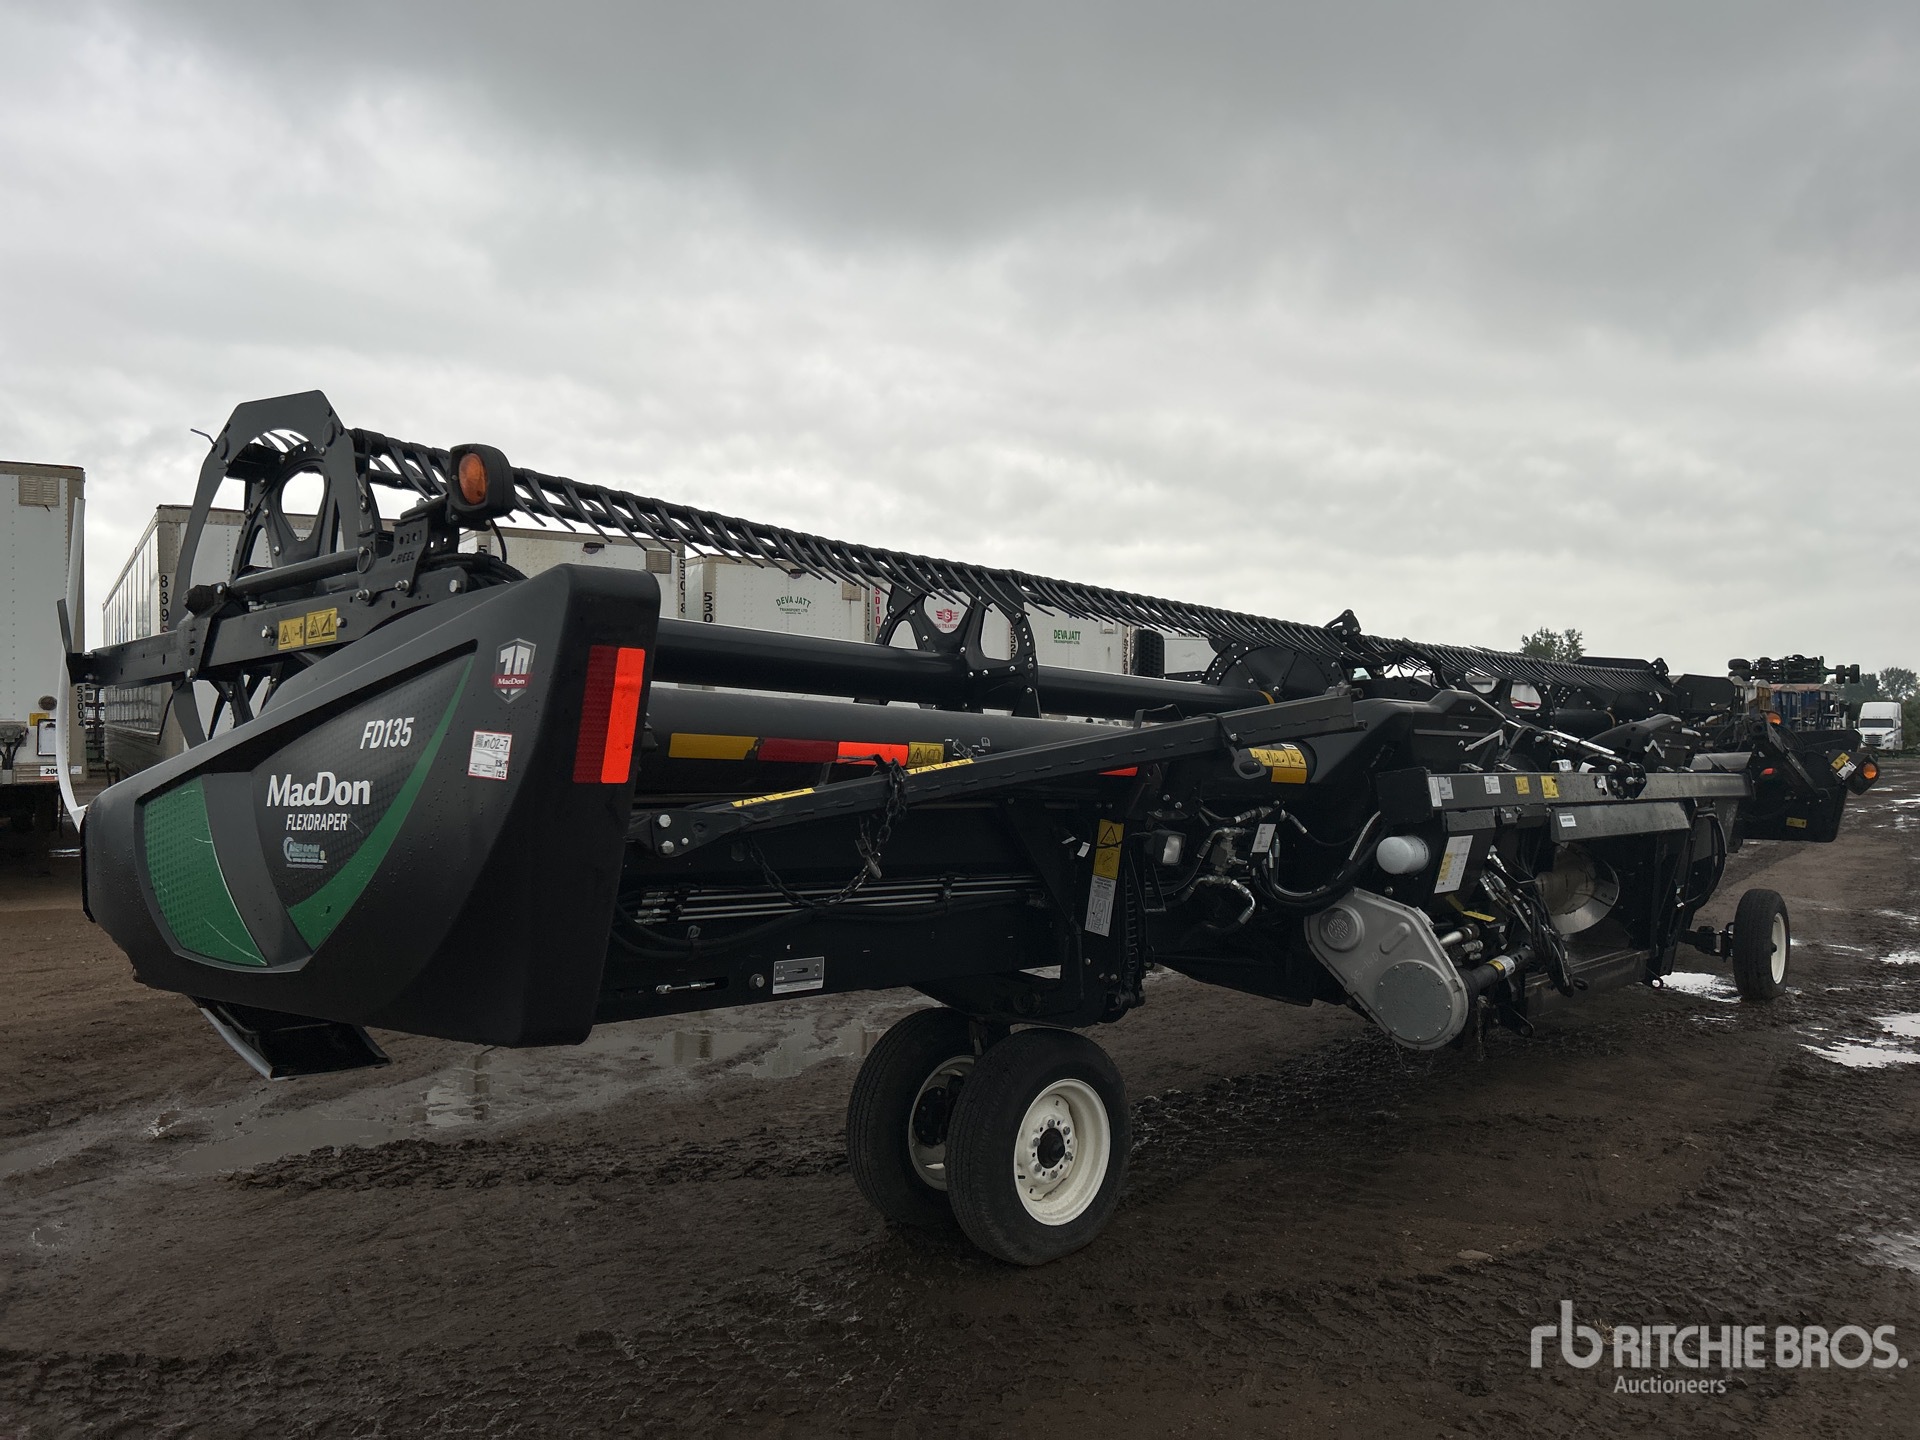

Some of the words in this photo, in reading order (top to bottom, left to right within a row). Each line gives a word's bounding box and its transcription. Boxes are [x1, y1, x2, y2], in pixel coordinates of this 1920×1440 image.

[775, 596, 793, 606] DEVA
[795, 596, 812, 609] JATT
[1053, 629, 1067, 640] DEVA
[1069, 630, 1081, 641] JATT
[497, 677, 525, 685] MacDon
[76, 685, 84, 728] 53004
[360, 717, 415, 750] FD135
[266, 771, 371, 807] MacDon
[286, 813, 348, 831] FLEXDRAPER
